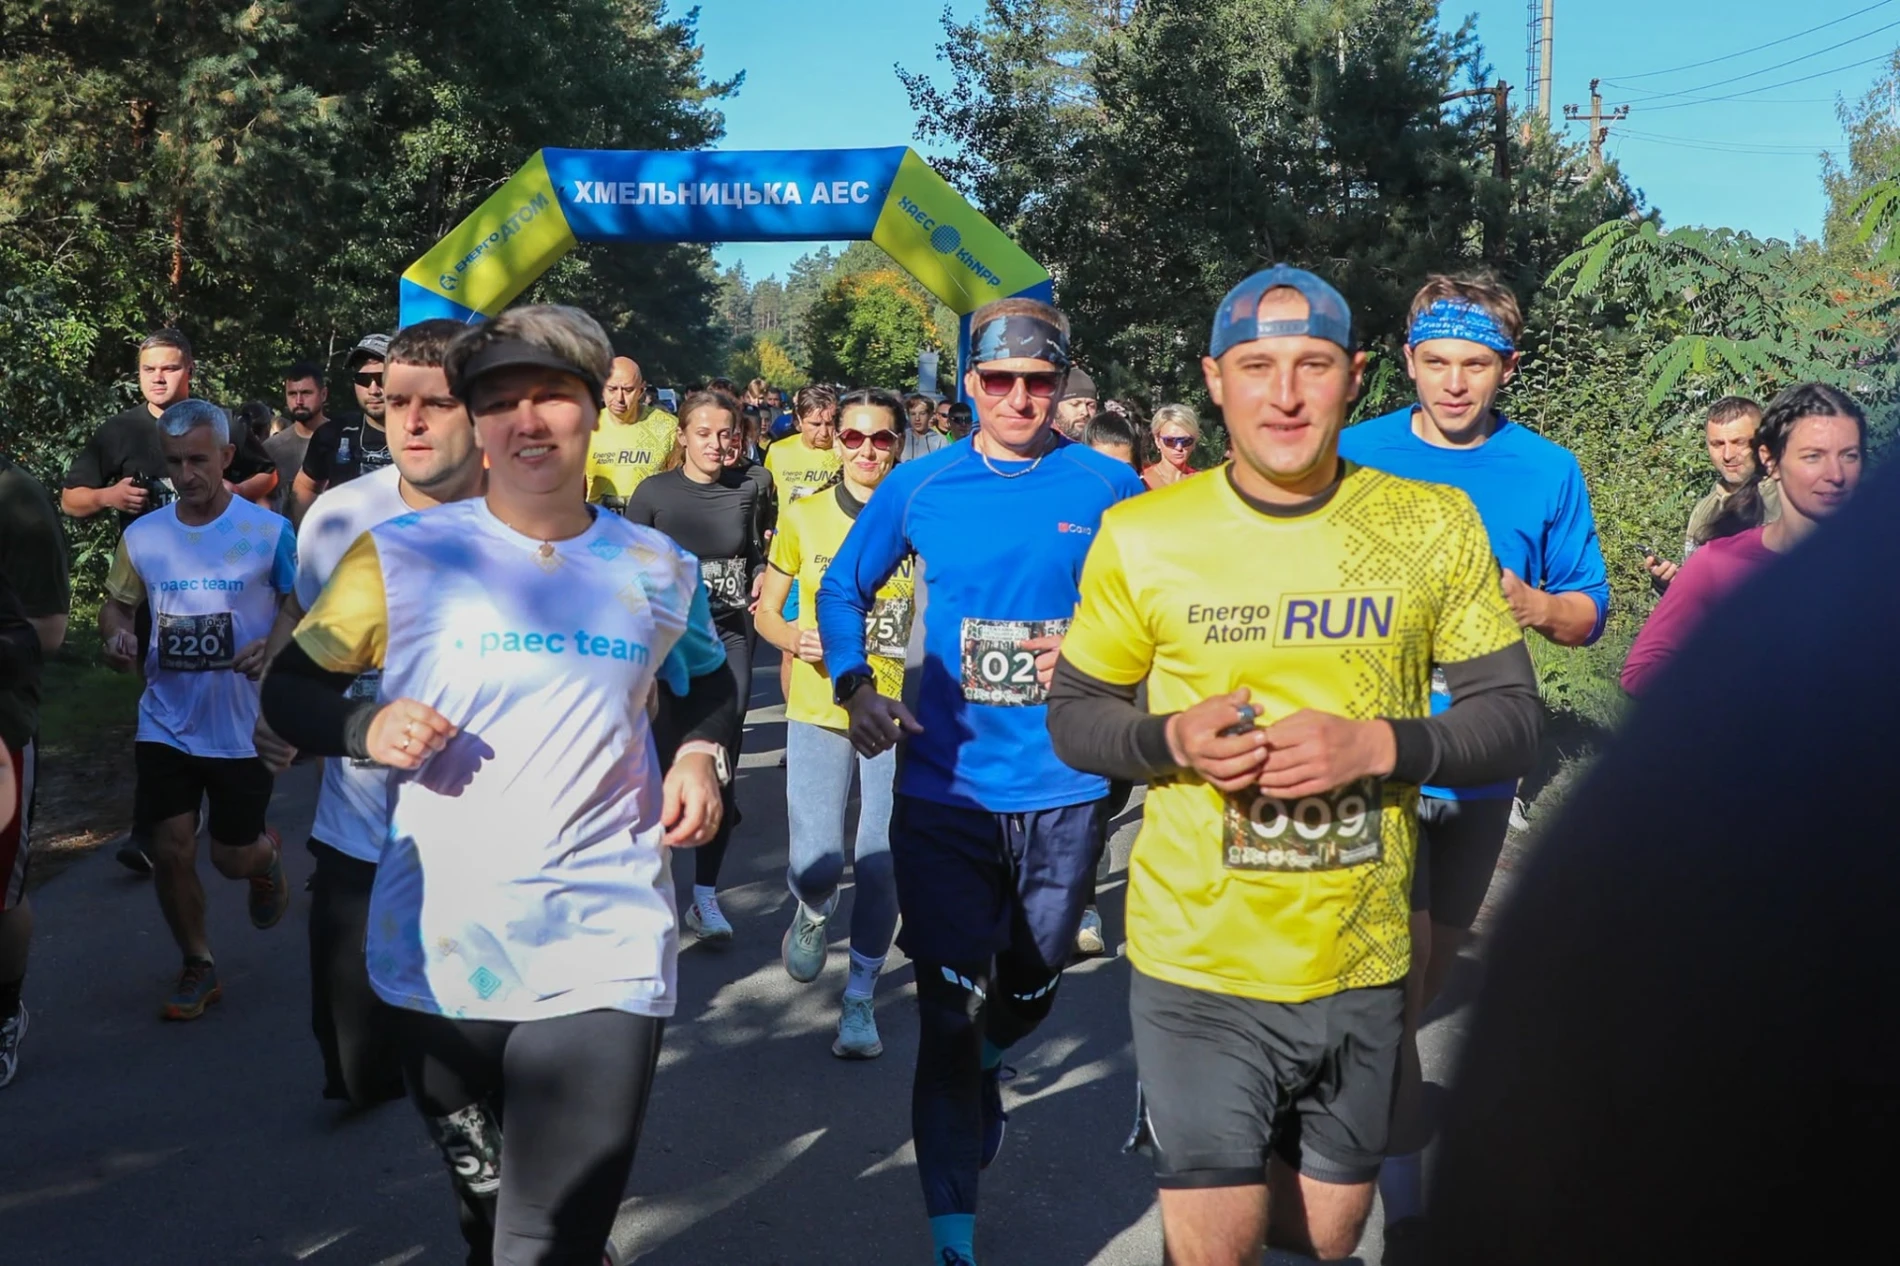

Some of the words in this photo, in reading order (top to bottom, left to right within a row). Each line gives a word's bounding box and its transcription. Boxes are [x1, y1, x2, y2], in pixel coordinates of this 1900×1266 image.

[574, 181, 802, 209] ХМЕЛЬНИЦЬКА
[810, 181, 870, 204] АЕС
[956, 247, 1001, 287] KhNPP
[592, 452, 616, 460] Energo
[617, 450, 651, 464] RUN
[804, 470, 834, 482] RUN
[160, 579, 199, 593] paec
[202, 577, 244, 592] team
[1188, 604, 1271, 625] Energo
[1282, 596, 1394, 640] RUN
[168, 634, 219, 656] 220
[1204, 625, 1267, 645] Atom
[480, 632, 565, 658] paec
[574, 629, 649, 666] team
[1251, 796, 1366, 840] 009
